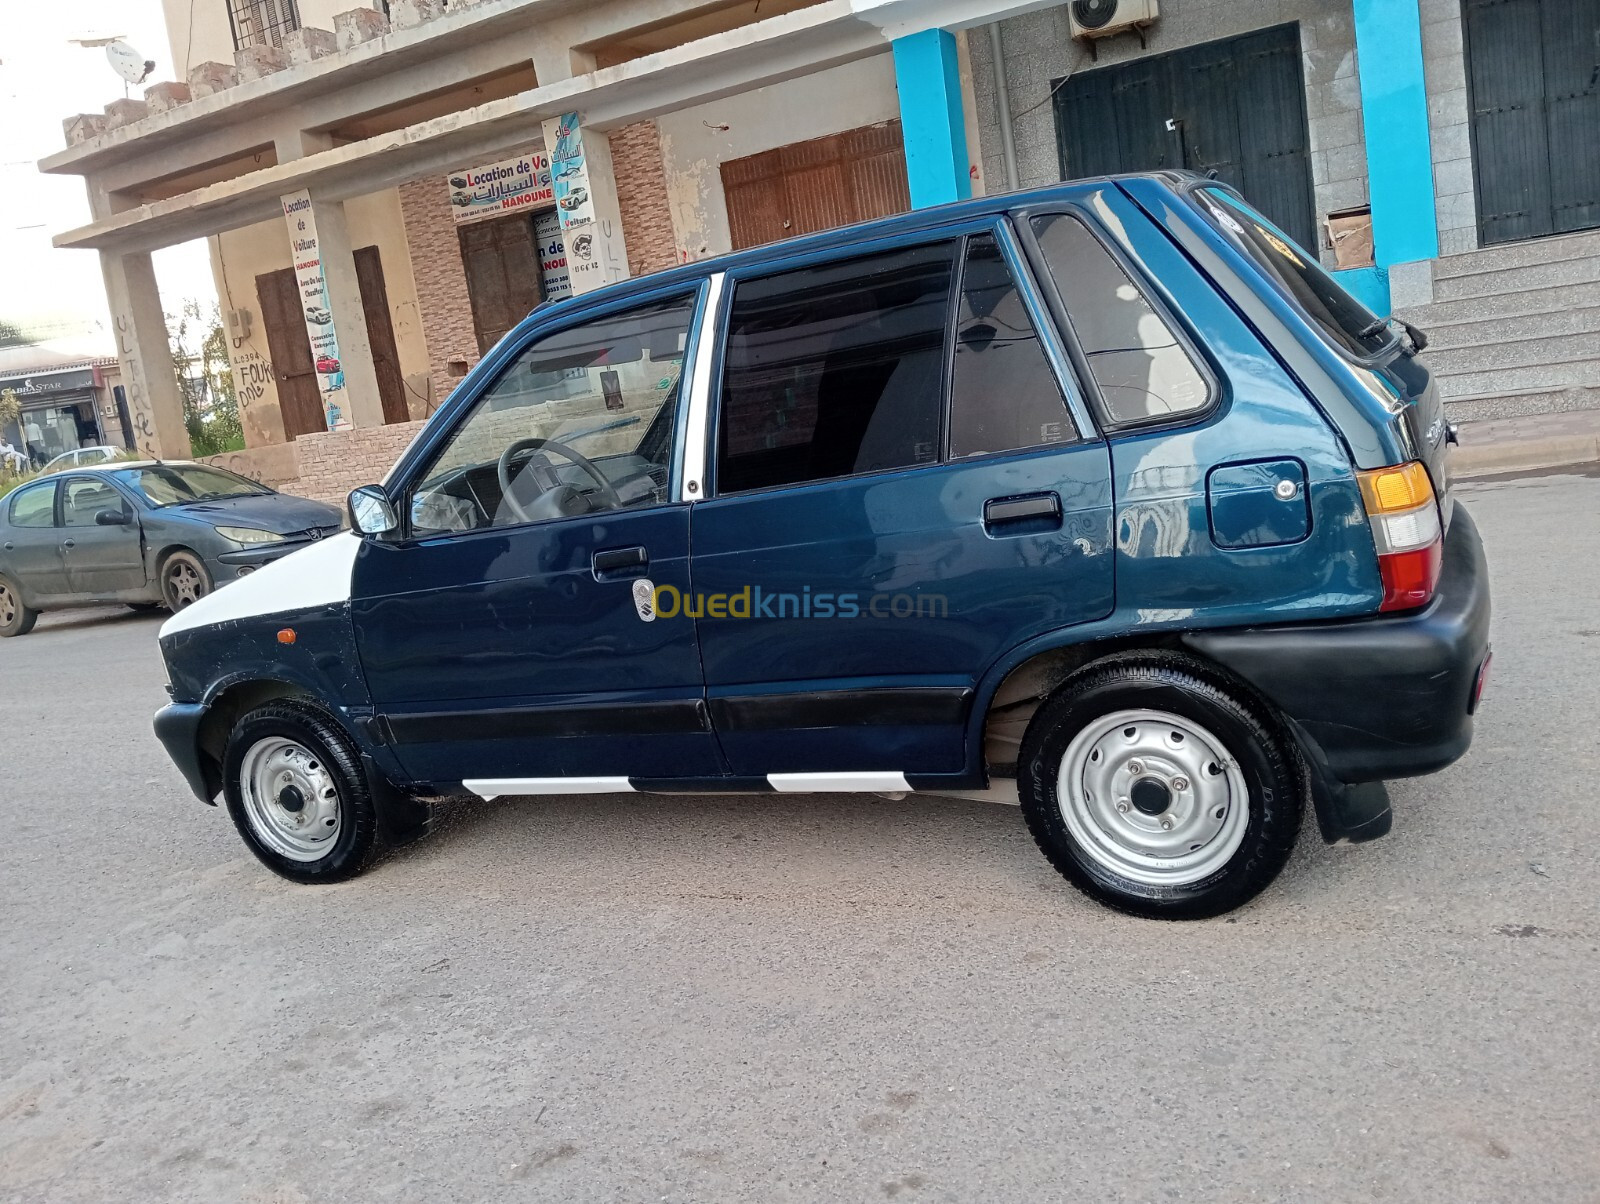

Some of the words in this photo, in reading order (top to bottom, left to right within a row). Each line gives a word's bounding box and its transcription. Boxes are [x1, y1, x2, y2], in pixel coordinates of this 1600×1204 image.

[555, 124, 571, 141] كراء
[550, 144, 582, 164] السيارات
[467, 166, 514, 187] Location
[517, 160, 530, 174] de
[473, 172, 538, 201] السيارات
[284, 198, 311, 214] Location
[502, 188, 553, 209] HANOUNE
[297, 218, 306, 231] de
[565, 216, 591, 227] Voiture
[293, 238, 316, 252] Voiture
[549, 241, 564, 255] de
[296, 259, 320, 271] HANOUNE
